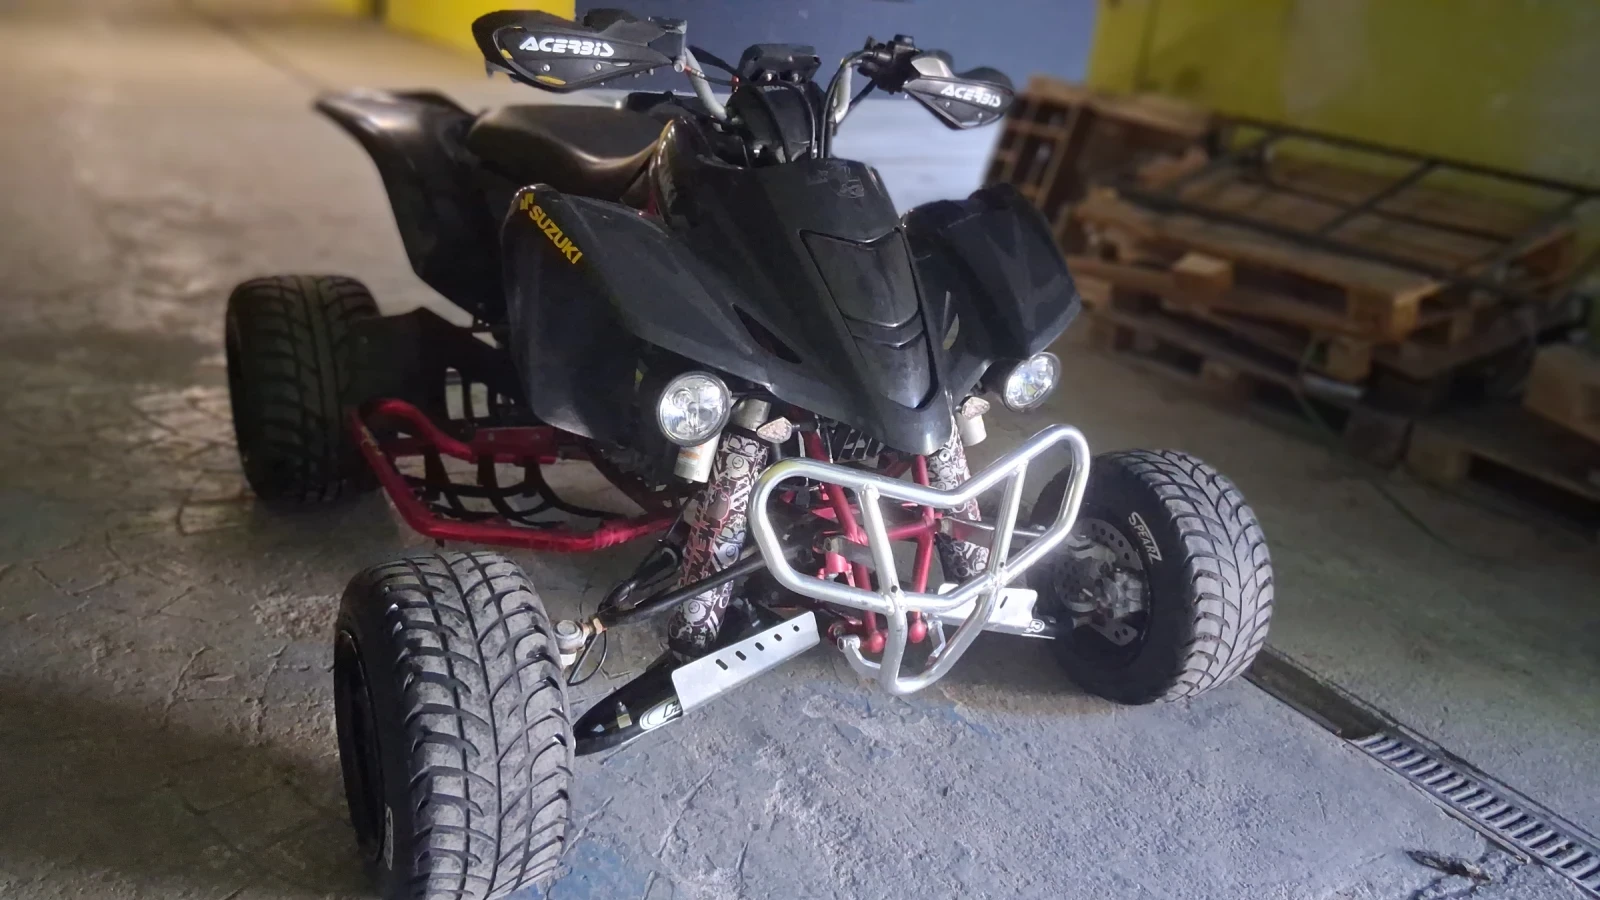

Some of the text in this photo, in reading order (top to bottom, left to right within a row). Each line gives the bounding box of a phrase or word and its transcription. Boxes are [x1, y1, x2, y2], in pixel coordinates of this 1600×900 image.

[519, 36, 615, 57] ACERBIS
[940, 84, 1002, 108] ACERBIS
[529, 205, 583, 264] SUZUKI
[1128, 511, 1162, 565] SPEARZ
